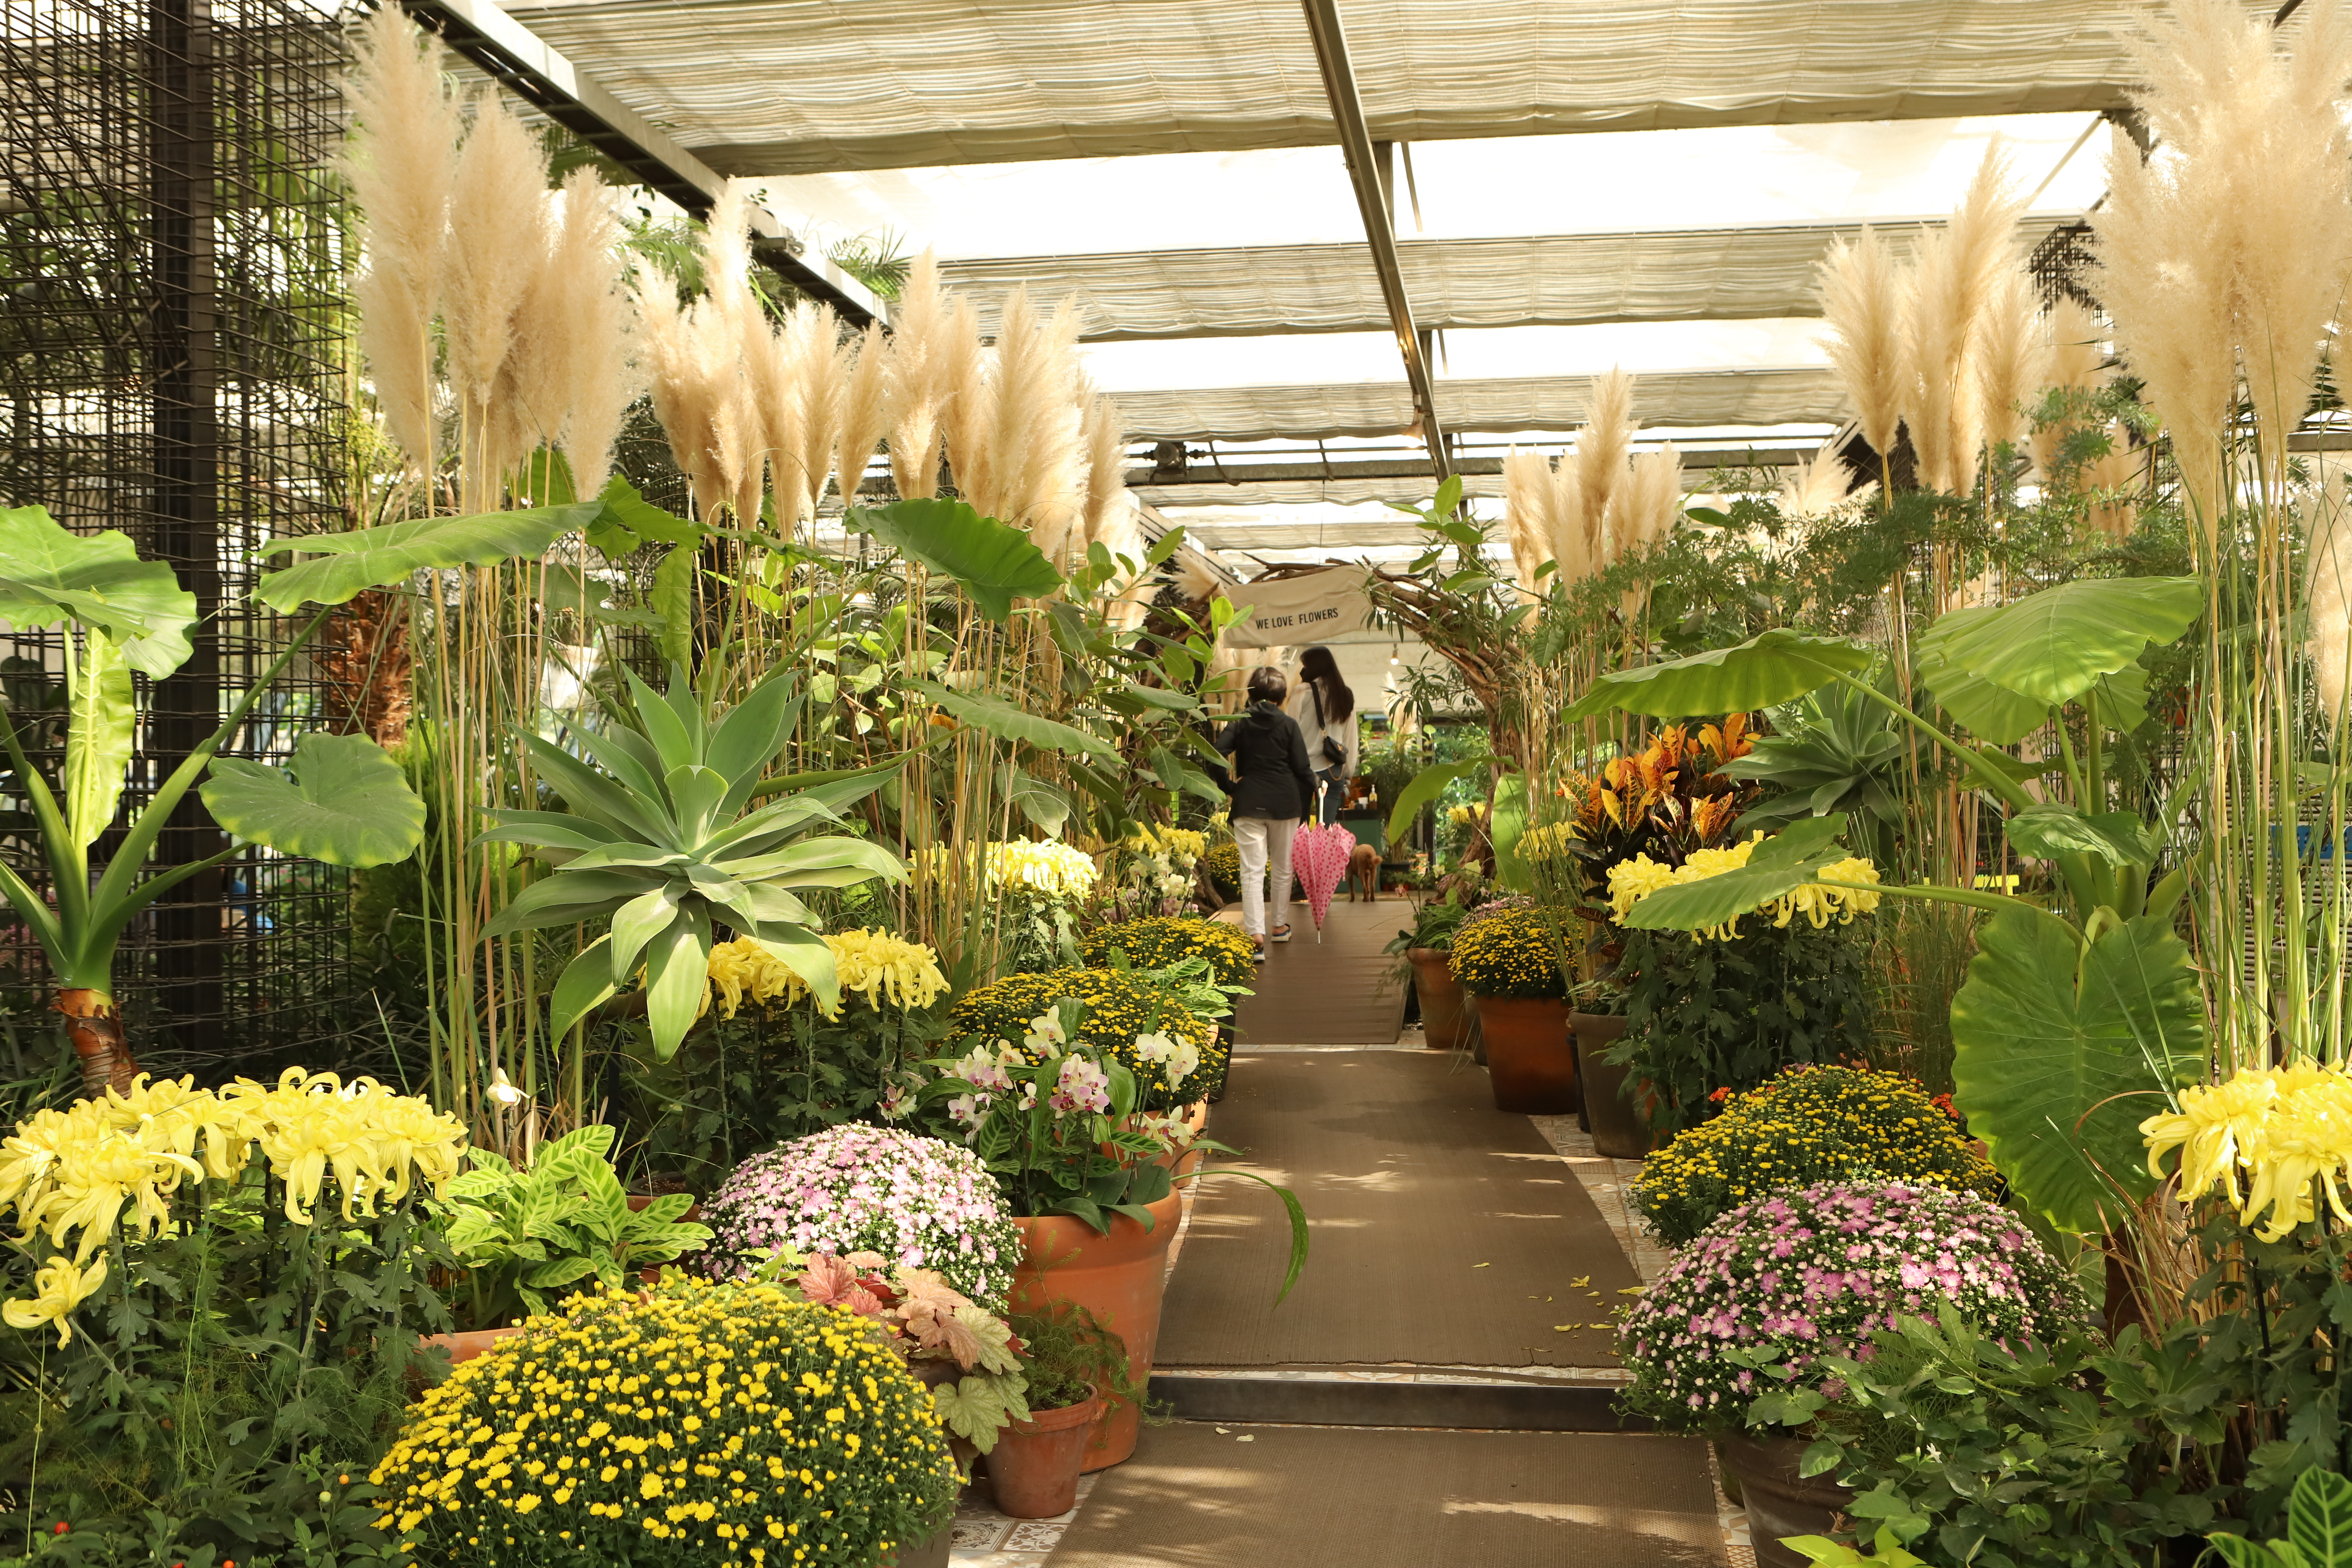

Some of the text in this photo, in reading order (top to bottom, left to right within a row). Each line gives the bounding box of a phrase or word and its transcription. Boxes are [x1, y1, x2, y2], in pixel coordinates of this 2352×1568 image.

[1256, 608, 1338, 629] WE LOVE FLOWERS
